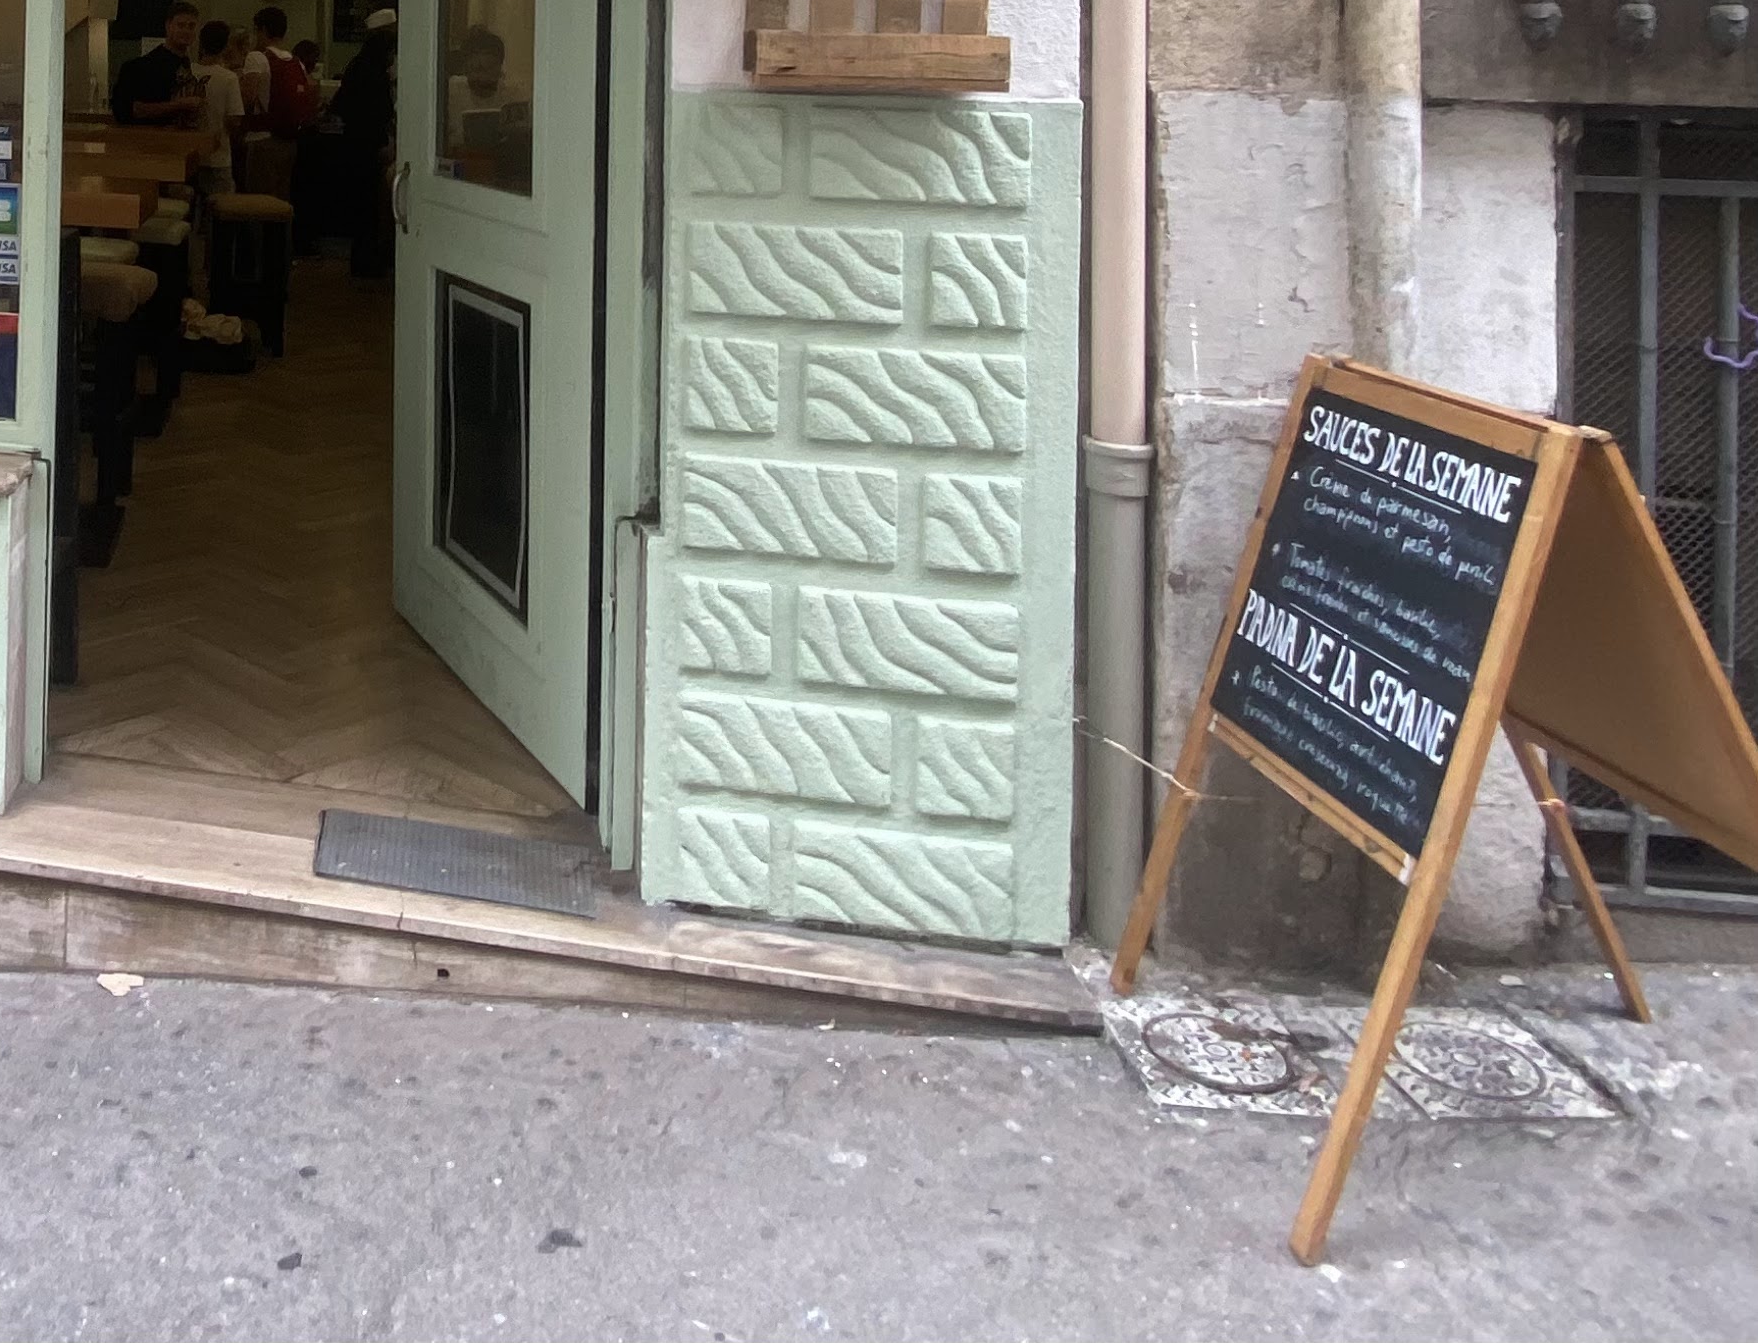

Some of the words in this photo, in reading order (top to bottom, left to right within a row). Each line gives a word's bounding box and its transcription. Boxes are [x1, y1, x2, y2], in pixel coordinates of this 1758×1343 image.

[1303, 406, 1380, 465] SAUCES
[1377, 432, 1408, 478] DE
[1404, 441, 1431, 487] LA
[1425, 451, 1521, 523] SEMAINE
[1297, 626, 1335, 684] DE
[1328, 645, 1357, 707] LA
[1361, 669, 1456, 765] SEMAINE
